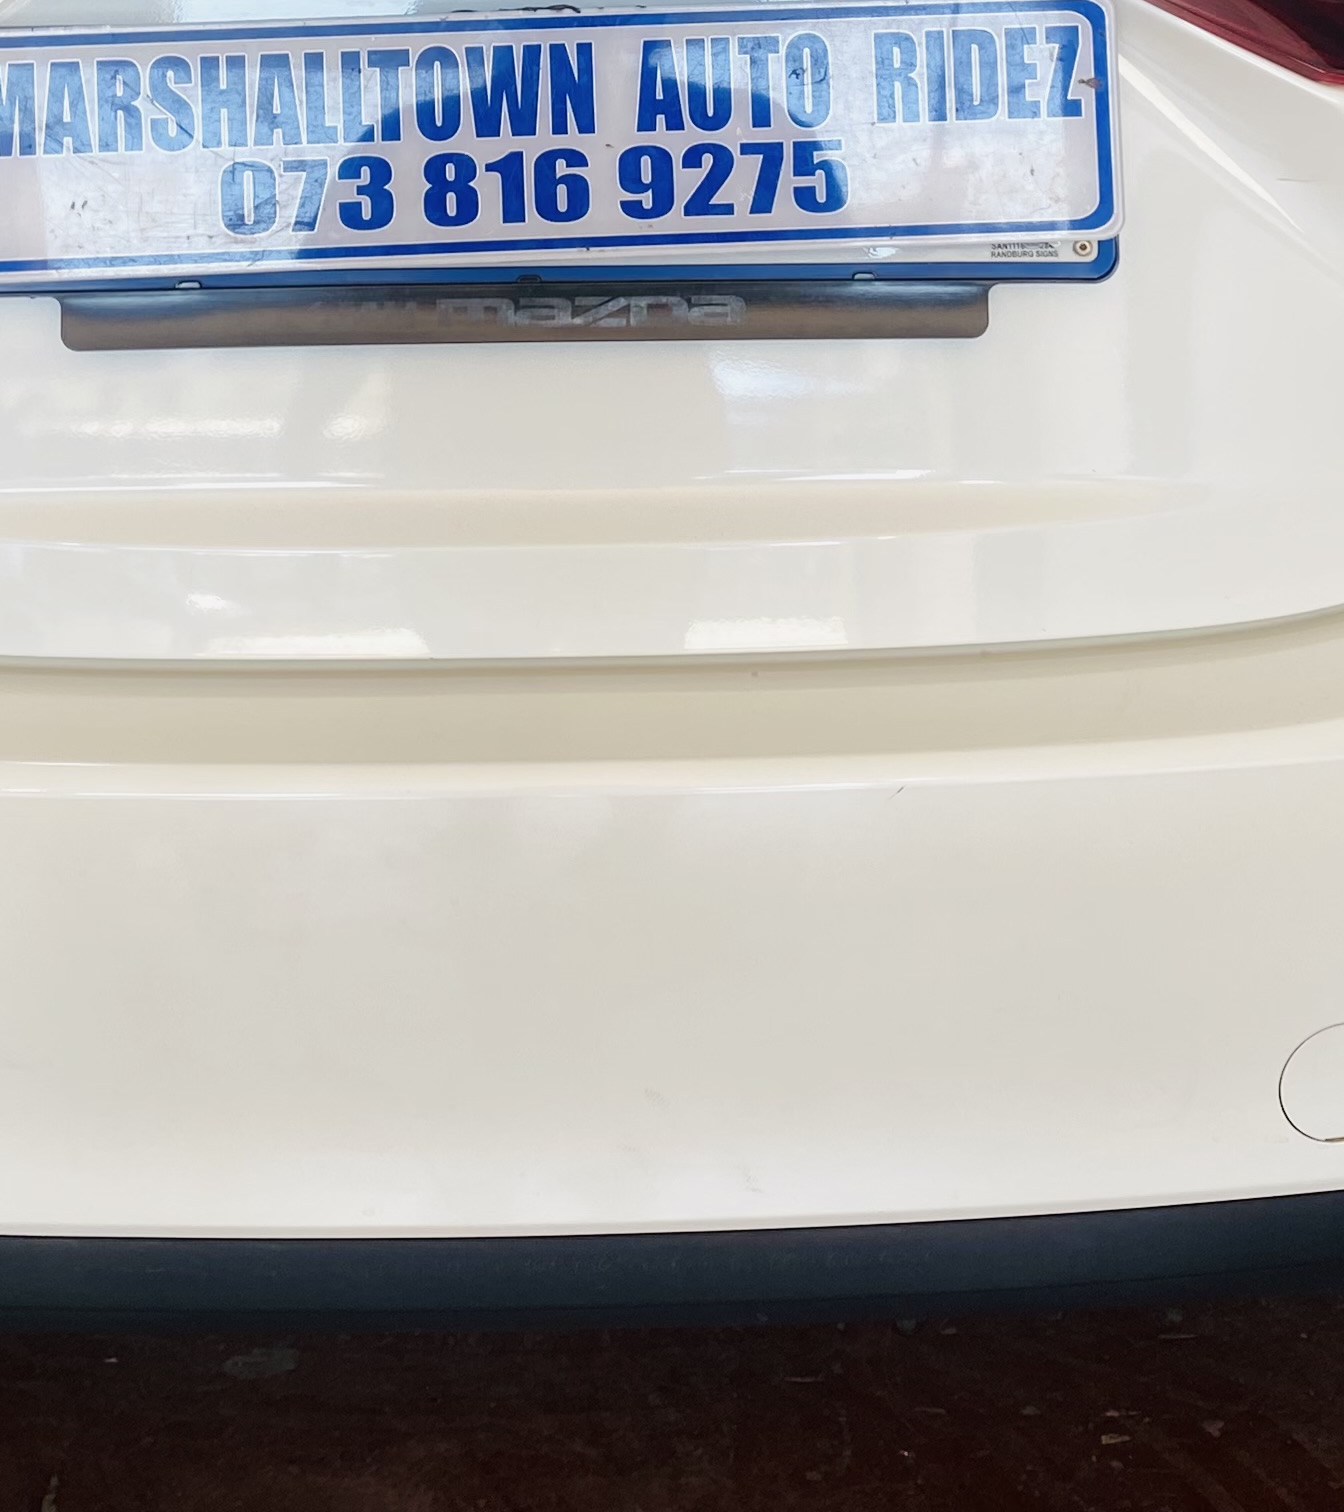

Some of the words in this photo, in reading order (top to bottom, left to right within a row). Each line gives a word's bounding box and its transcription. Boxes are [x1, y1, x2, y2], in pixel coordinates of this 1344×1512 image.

[636, 32, 831, 133] AUTO
[873, 24, 1084, 125] RIDEZ
[221, 153, 396, 235] 073
[422, 146, 591, 228] 816
[617, 139, 849, 221] 9275
